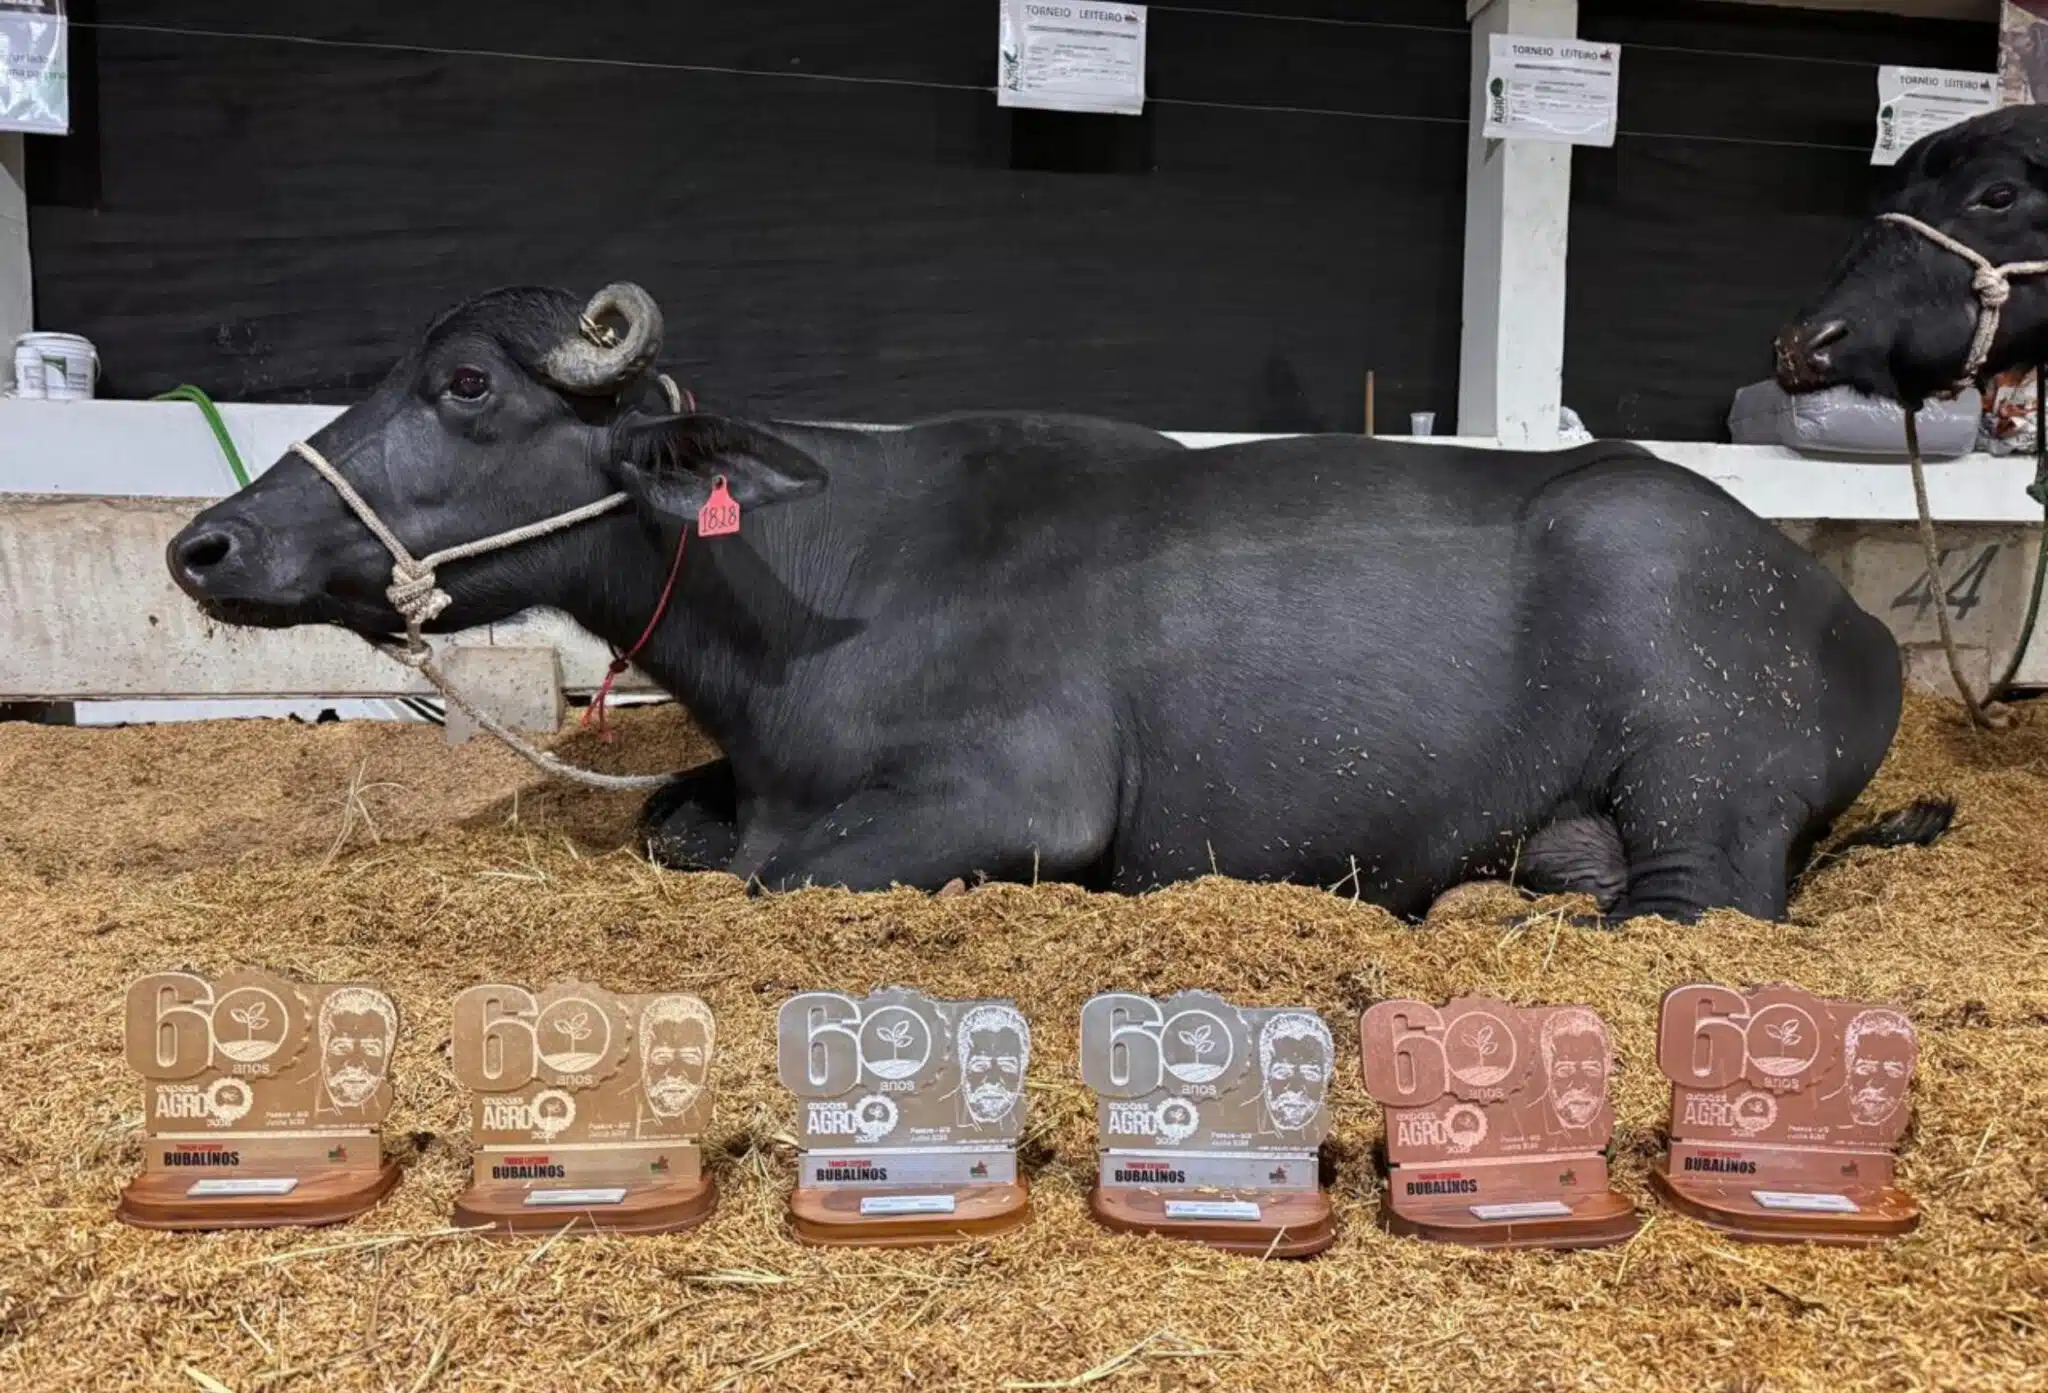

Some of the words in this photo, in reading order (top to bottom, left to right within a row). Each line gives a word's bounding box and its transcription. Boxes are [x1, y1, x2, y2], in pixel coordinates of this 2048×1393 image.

[1026, 4, 1071, 17] TORNEIO
[1079, 9, 1122, 23] LEITEIRO
[1512, 44, 1554, 57] TORNEIO
[1561, 48, 1598, 60] LEITEIRO
[1900, 75, 1940, 86] TORNEIO
[1944, 77, 1979, 90] LEITEIRO
[1890, 544, 1999, 621] 44
[232, 1062, 270, 1075] anos
[556, 1073, 593, 1086] anos
[879, 1080, 916, 1092] anos
[1764, 1076, 1800, 1090] anos
[1181, 1083, 1217, 1096] anos
[155, 1093, 209, 1119] AGRO
[1682, 1101, 1735, 1127] AGRO
[481, 1105, 533, 1131] AGRO
[807, 1109, 857, 1135] AGRO
[1108, 1110, 1157, 1136] AGRO
[1396, 1120, 1449, 1148] AGRO
